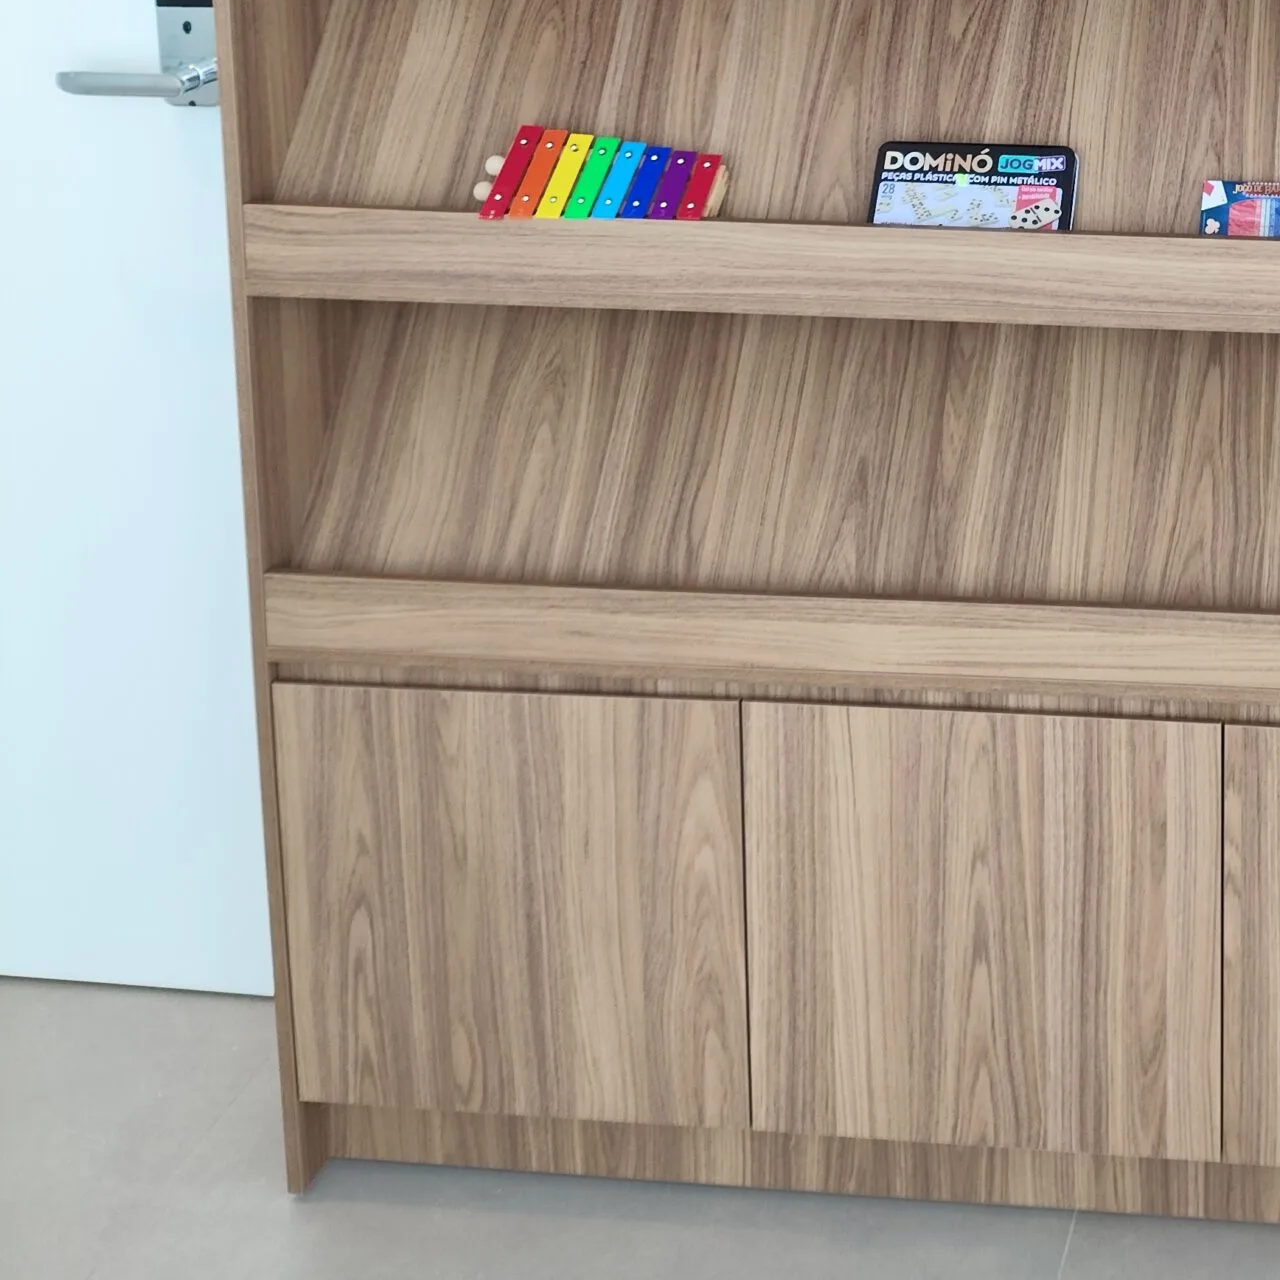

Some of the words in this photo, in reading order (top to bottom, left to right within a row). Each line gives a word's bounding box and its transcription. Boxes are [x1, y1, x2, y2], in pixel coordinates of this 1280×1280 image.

[881, 172, 912, 182] PEÇAS
[913, 172, 967, 184] PLÁSTIC
[968, 174, 990, 184] COM
[991, 175, 1008, 184] PIN
[1009, 175, 1058, 186] METÁLICO
[882, 183, 896, 195] 28
